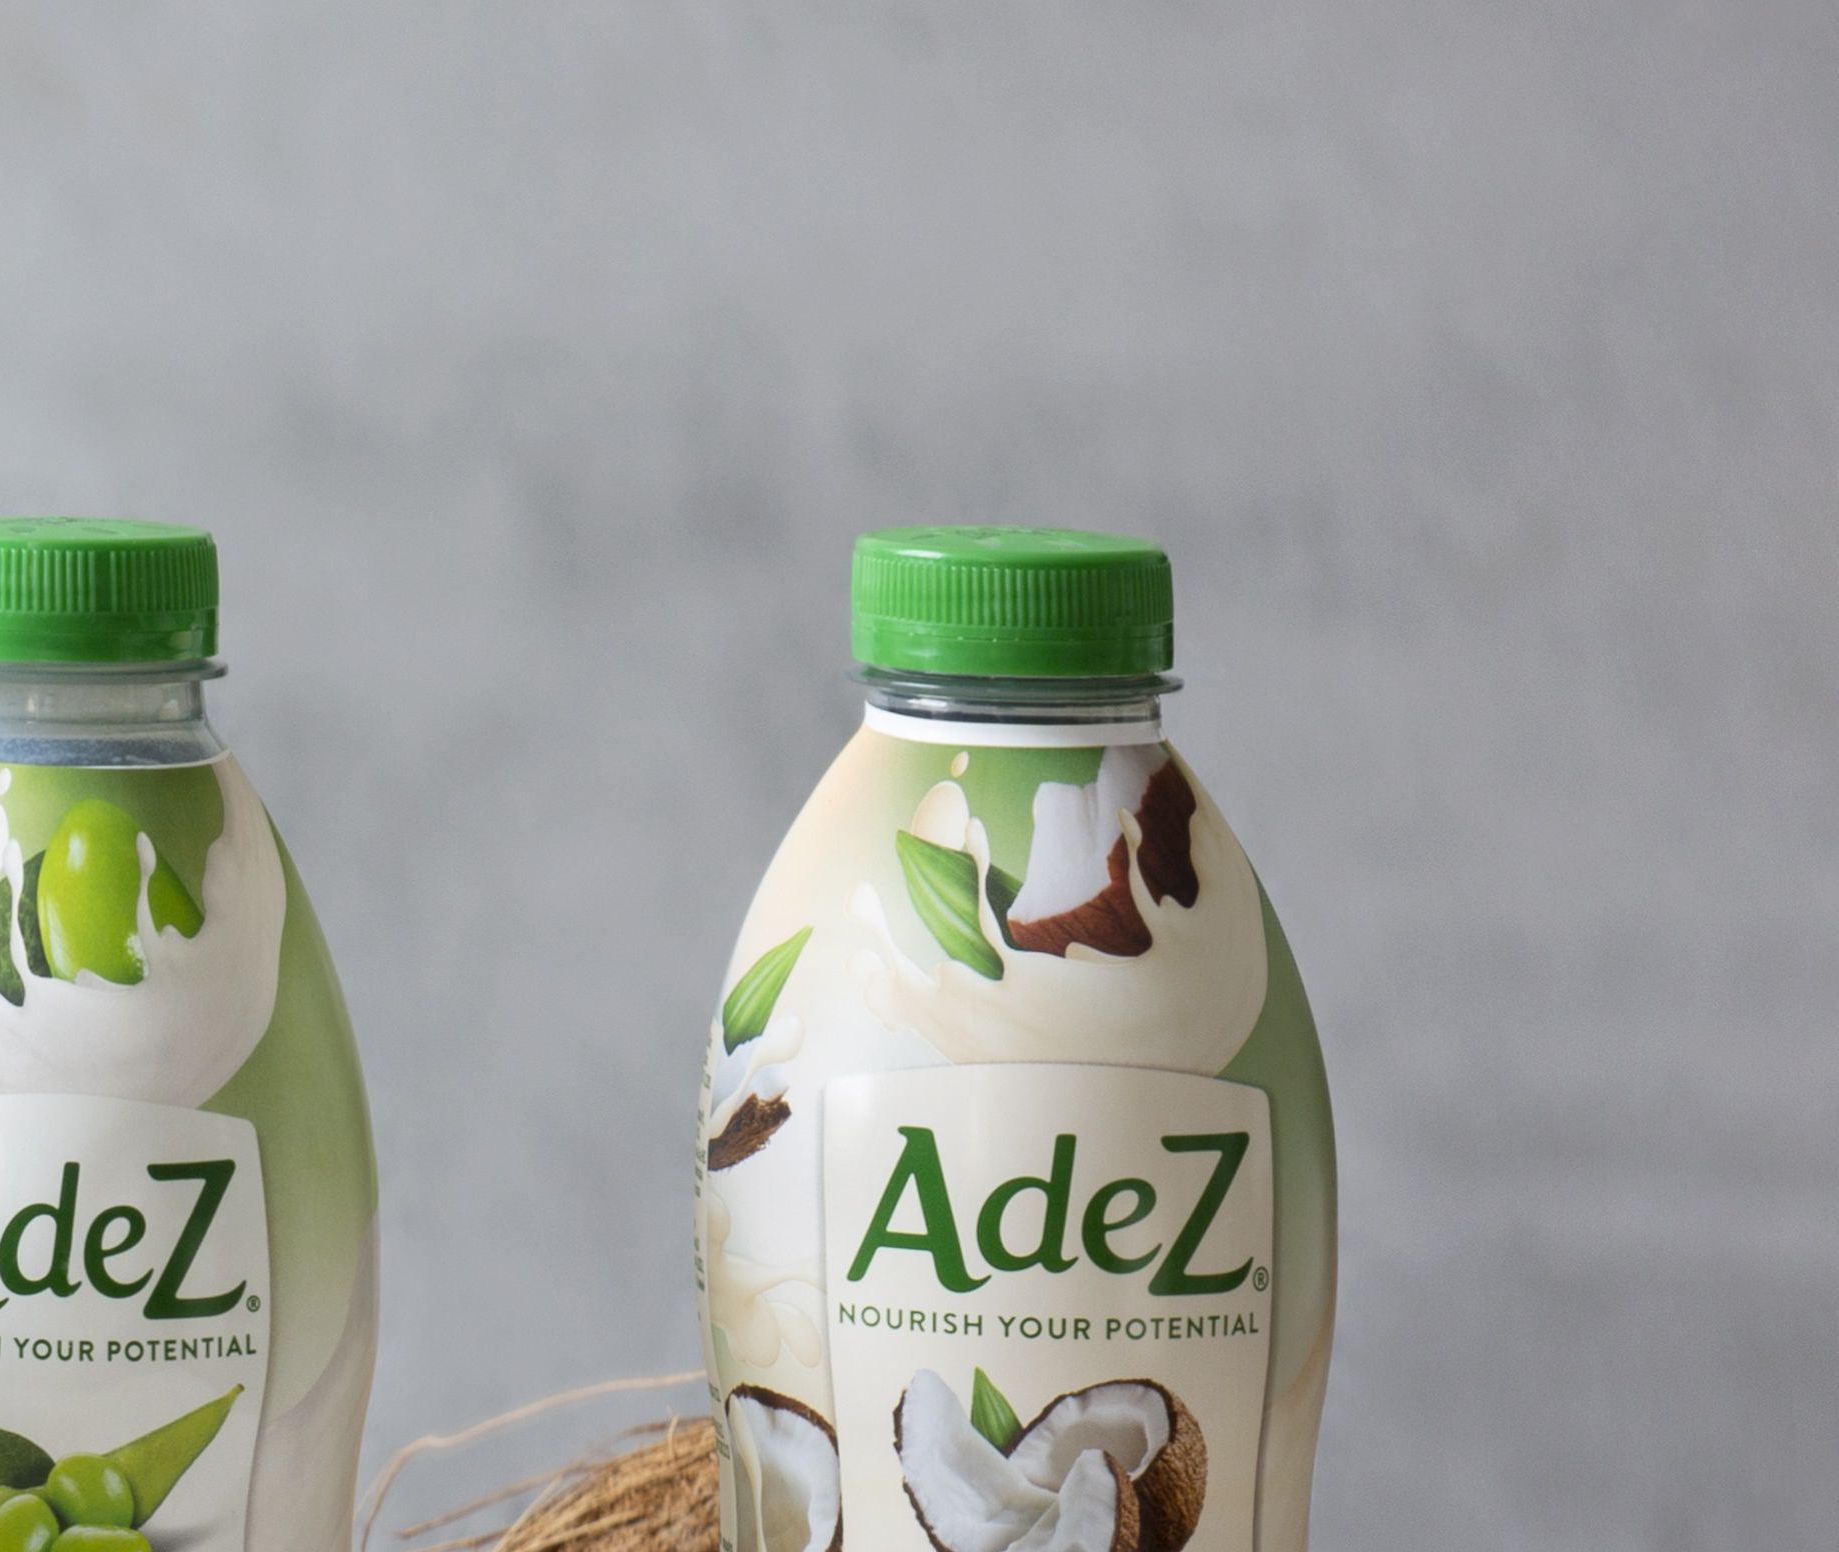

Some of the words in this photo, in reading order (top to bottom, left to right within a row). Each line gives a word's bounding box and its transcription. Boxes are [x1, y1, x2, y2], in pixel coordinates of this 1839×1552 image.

[839, 1302, 984, 1337] NOURISH
[997, 1315, 1091, 1340] YOUR
[1105, 1311, 1259, 1340] POTENTIAL
[13, 1336, 95, 1363] YOUR
[107, 1332, 257, 1363] POTENTIAL
